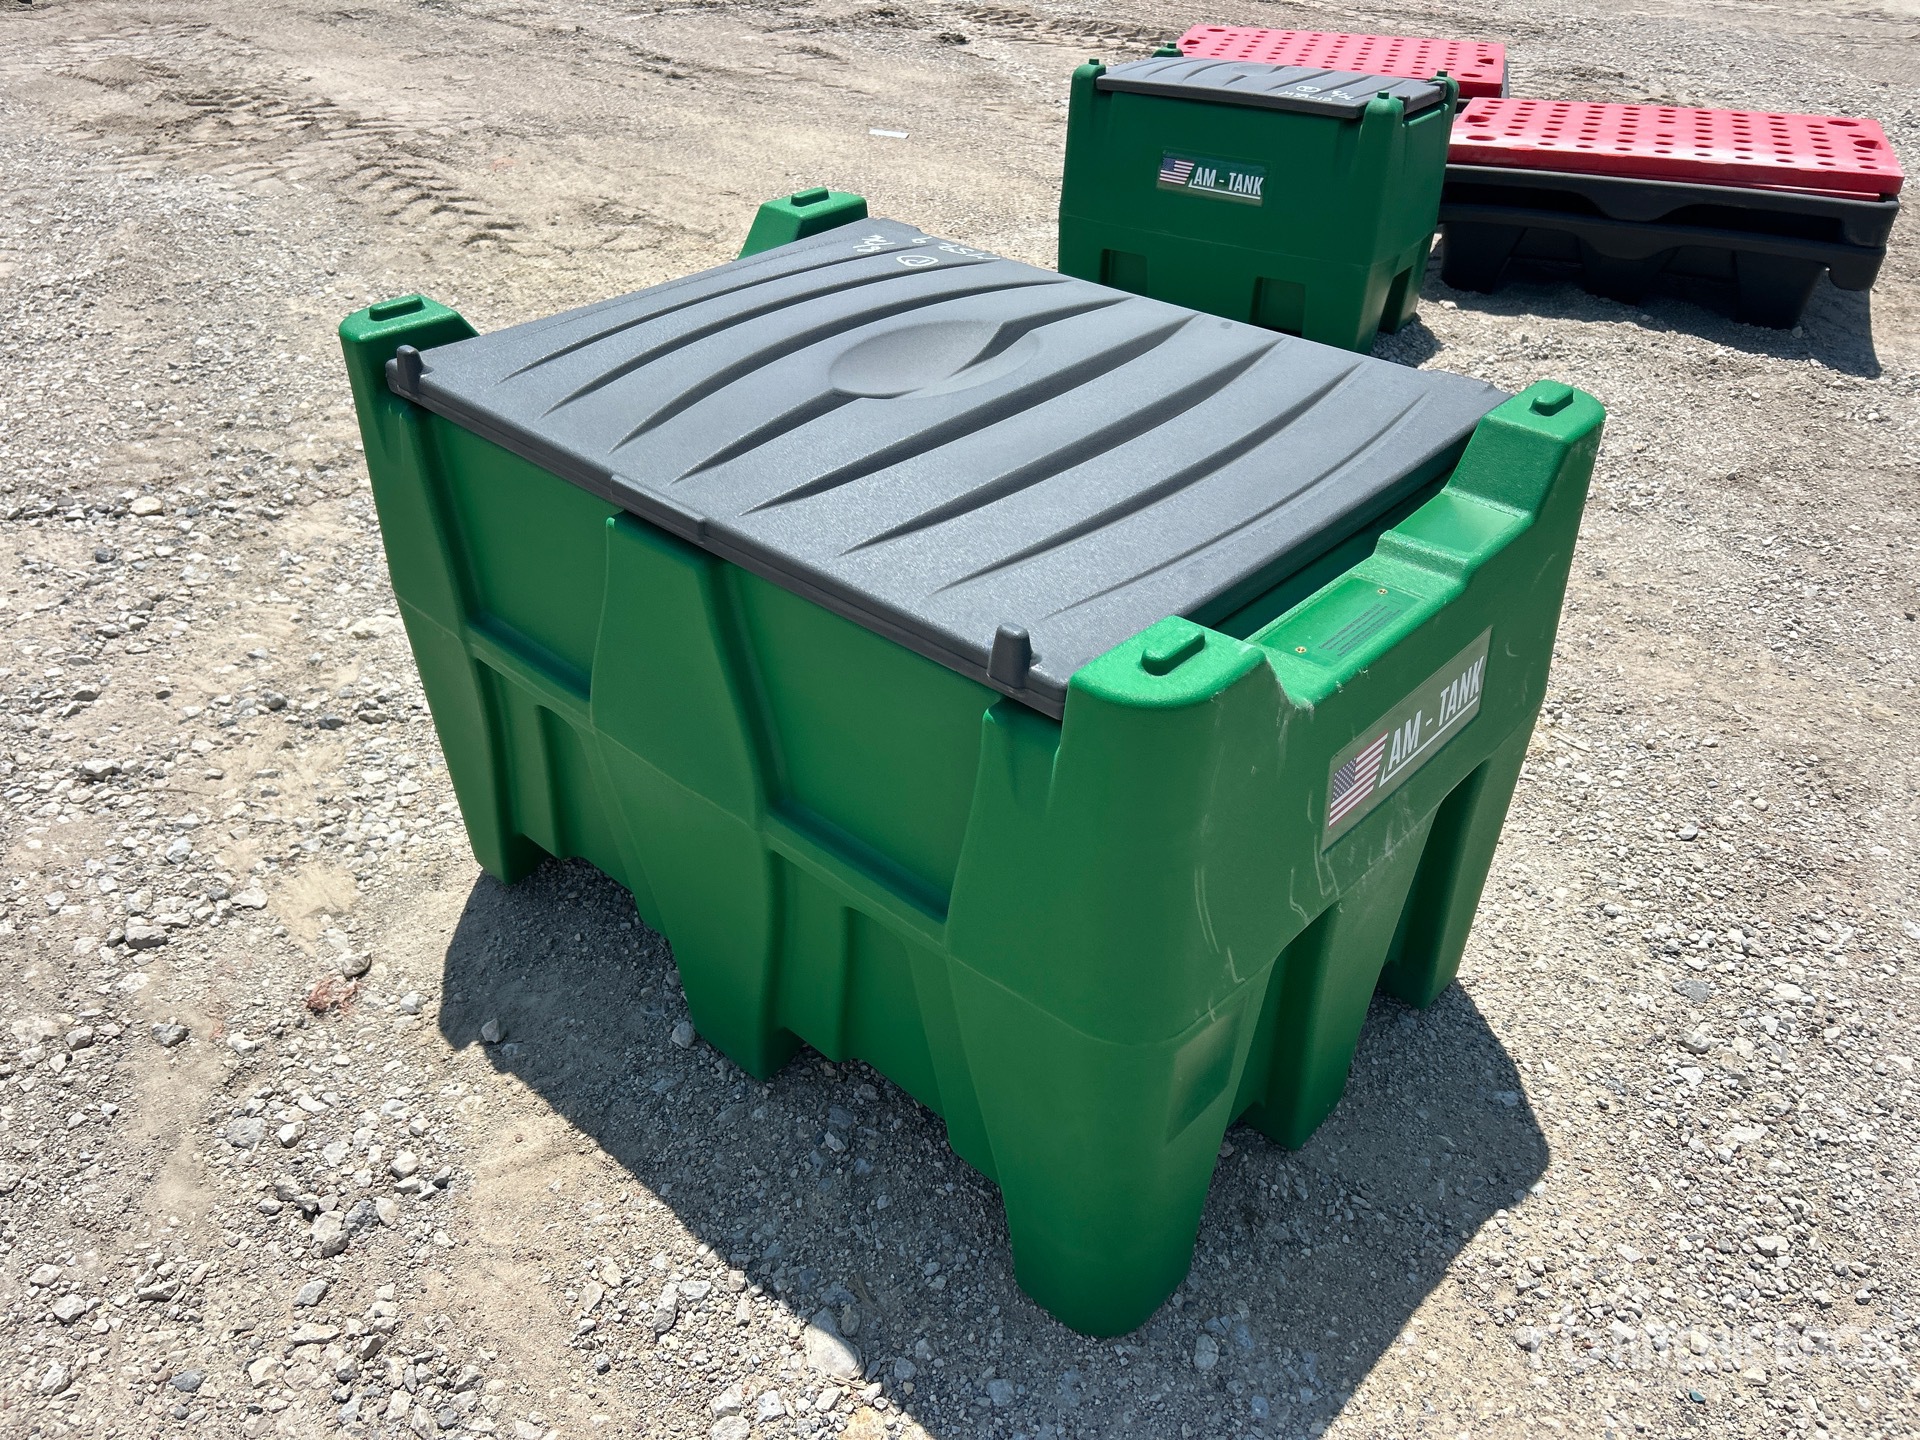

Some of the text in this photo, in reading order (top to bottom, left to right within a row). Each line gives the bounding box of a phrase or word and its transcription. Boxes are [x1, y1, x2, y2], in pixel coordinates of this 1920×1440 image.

[1193, 167, 1217, 187] AM
[1228, 172, 1264, 196] TANK
[1388, 710, 1422, 771] AM
[1439, 655, 1485, 727] TANK
